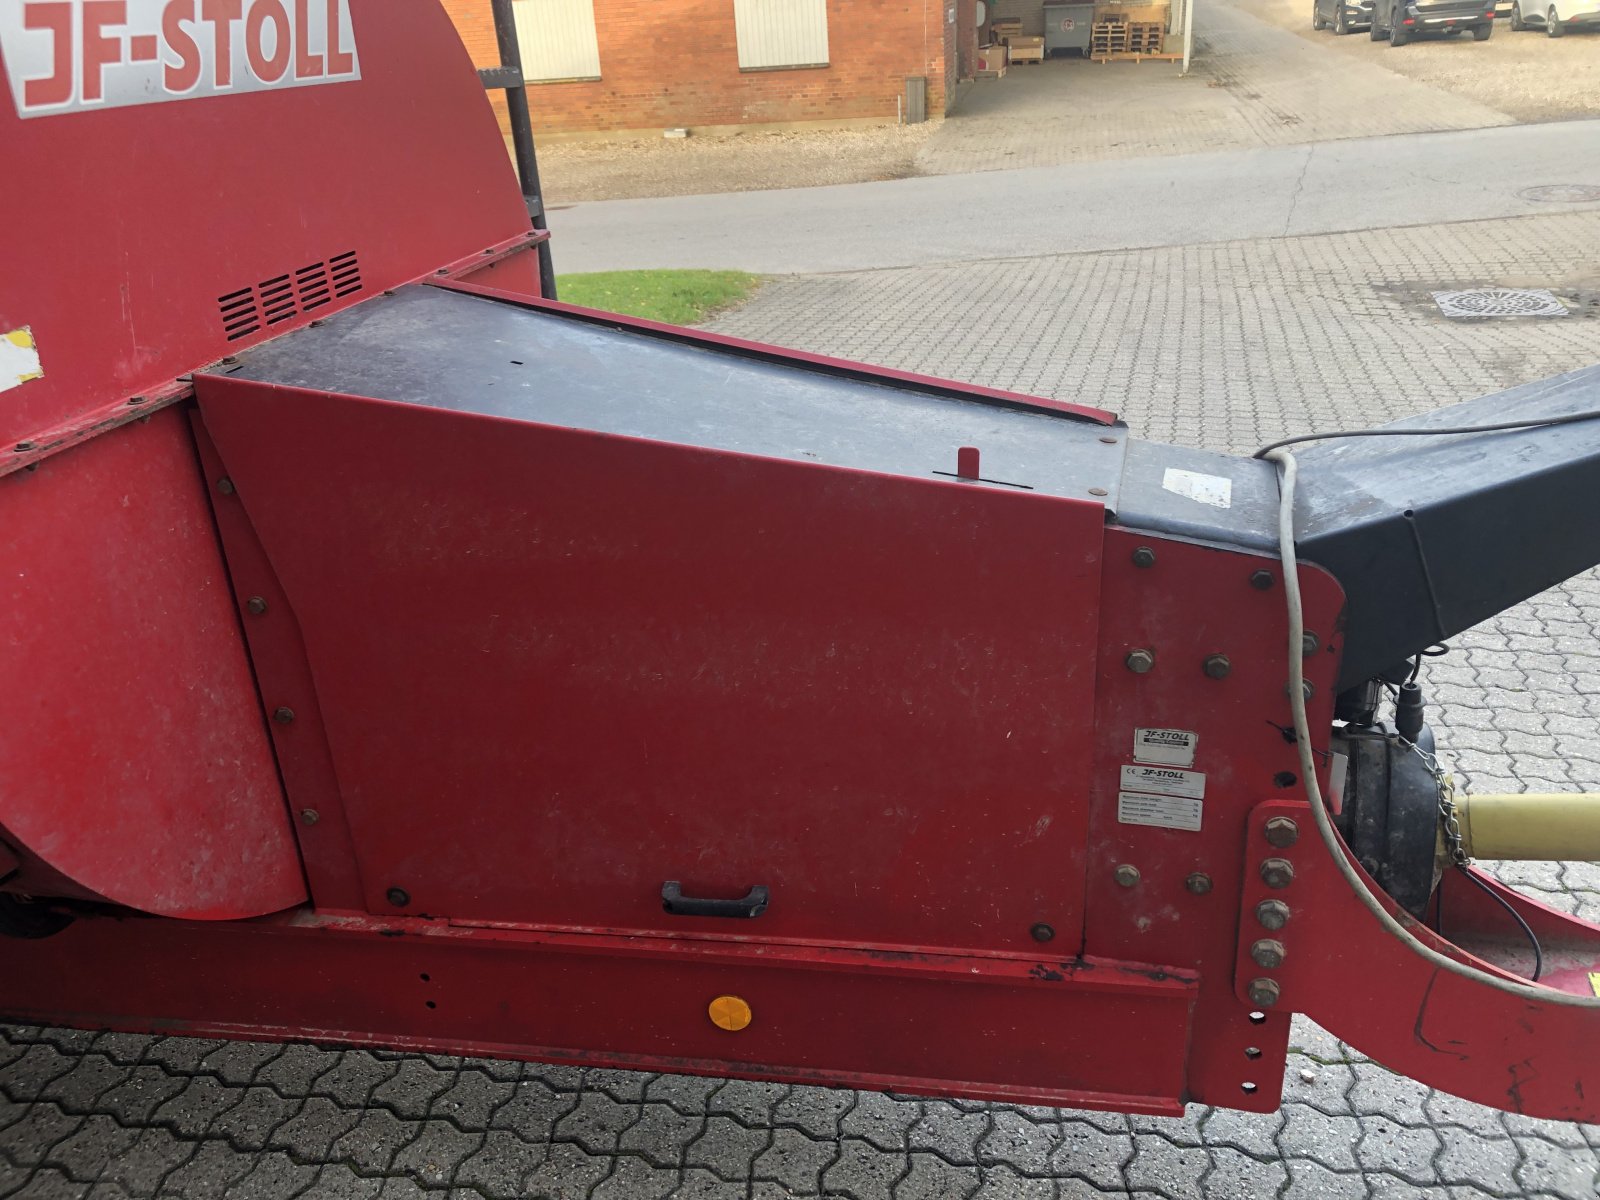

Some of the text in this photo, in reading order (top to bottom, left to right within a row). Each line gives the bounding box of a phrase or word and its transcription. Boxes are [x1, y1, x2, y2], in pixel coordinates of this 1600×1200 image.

[23, 0, 354, 109] JF-STOLL
[1144, 731, 1189, 740] JF-STOLL
[1142, 769, 1184, 779] JF-STOLL
